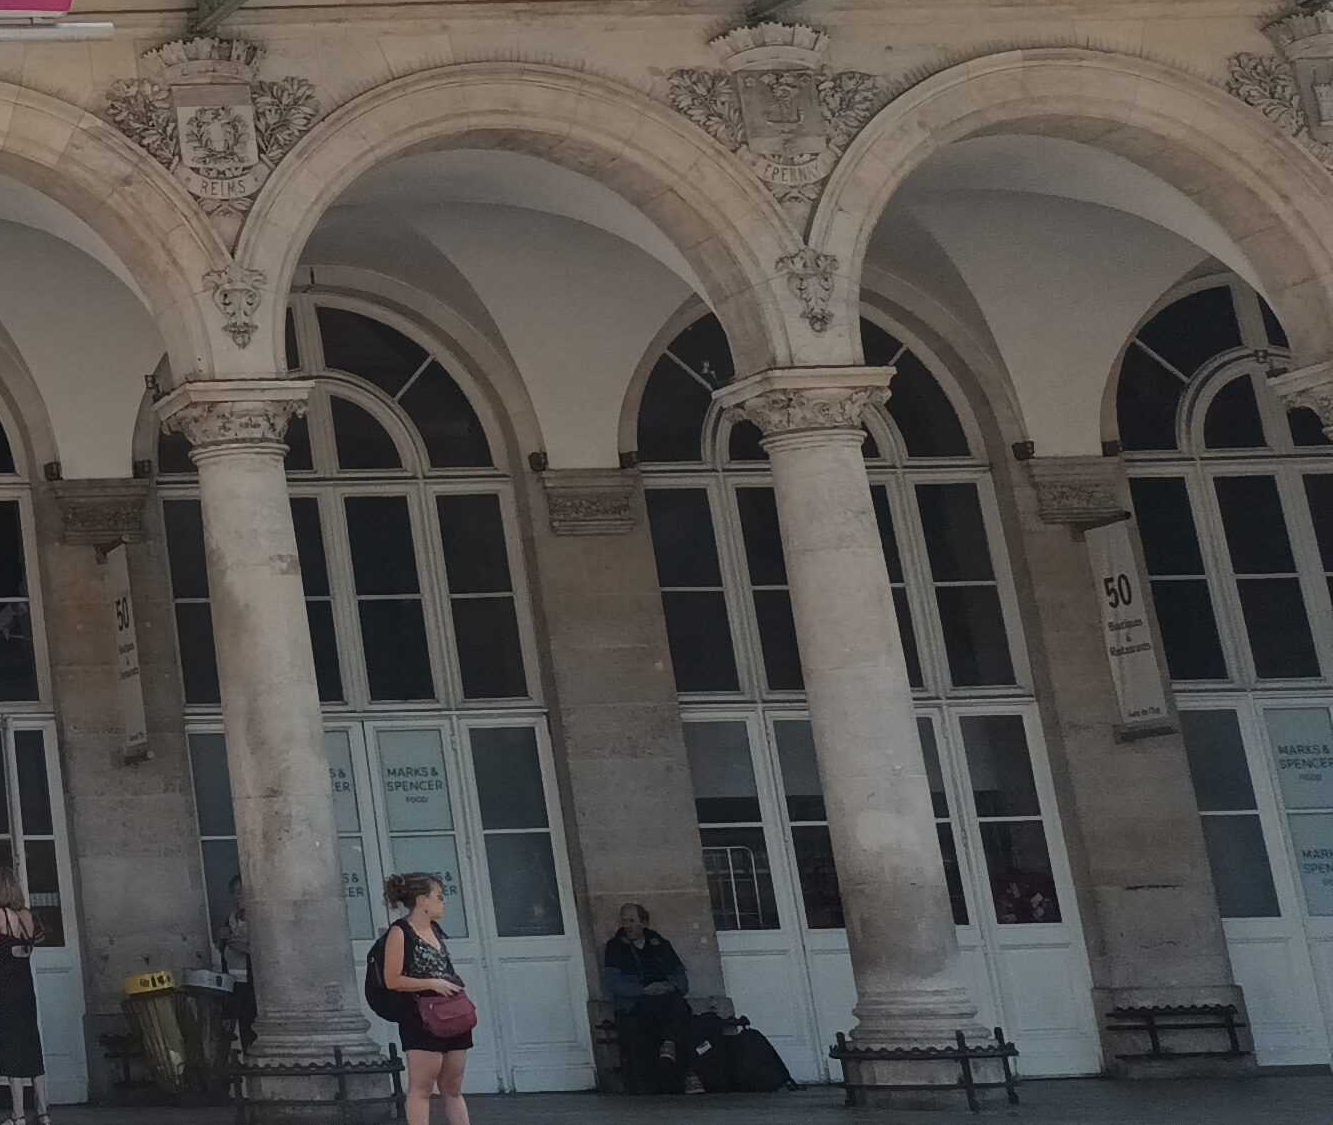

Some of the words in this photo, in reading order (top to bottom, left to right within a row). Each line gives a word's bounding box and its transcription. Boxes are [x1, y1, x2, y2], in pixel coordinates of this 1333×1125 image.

[201, 179, 246, 197] REIMS
[1103, 573, 1133, 608] 50
[115, 596, 129, 632] 50
[1277, 744, 1320, 756] MARKS
[387, 766, 429, 777] MARKS
[430, 766, 439, 776] &
[386, 779, 444, 792] SPENCER
